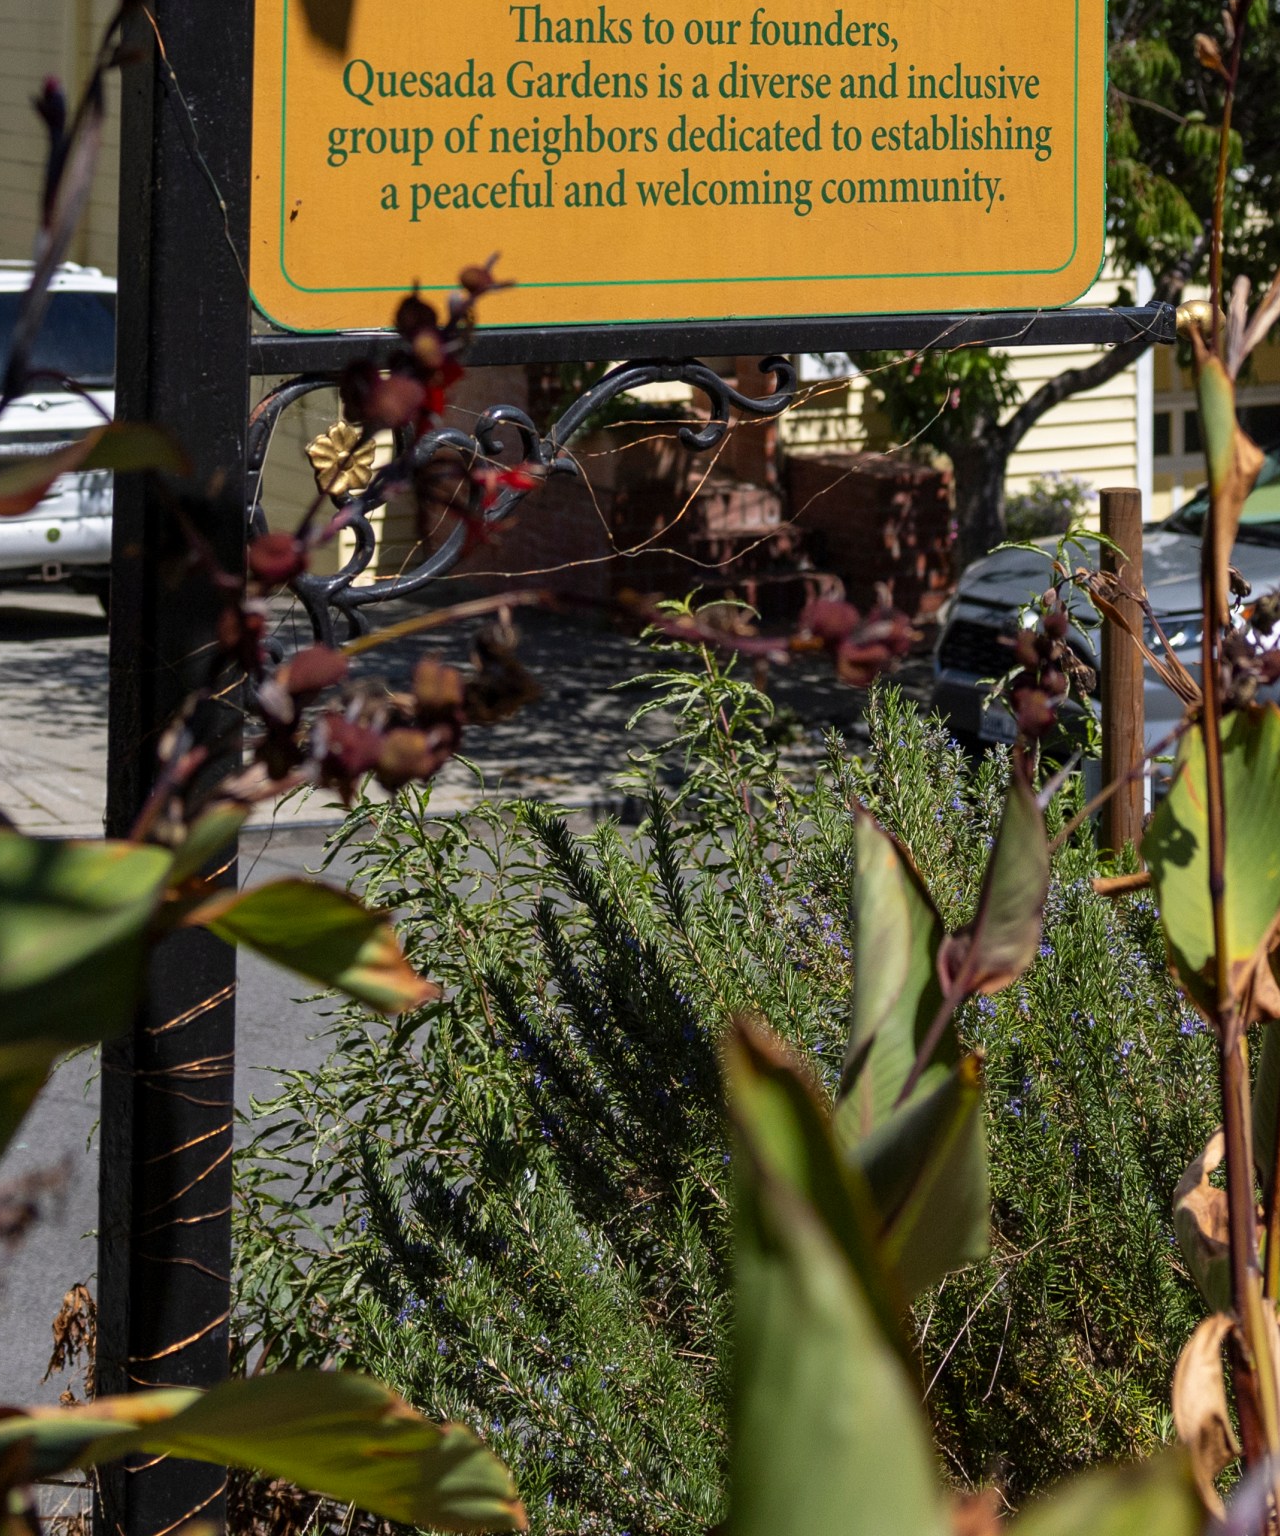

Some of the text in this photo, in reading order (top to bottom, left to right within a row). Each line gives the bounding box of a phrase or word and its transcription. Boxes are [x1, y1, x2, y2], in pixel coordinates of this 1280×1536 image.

[509, 3, 900, 54] Thanks to our founders,
[342, 58, 1042, 106] Quesada Gardens is a diverse and inclusive
[326, 110, 1054, 169] group of neighbors dedicated to establishing
[379, 166, 1007, 224] a peaceful and welcoming community.
